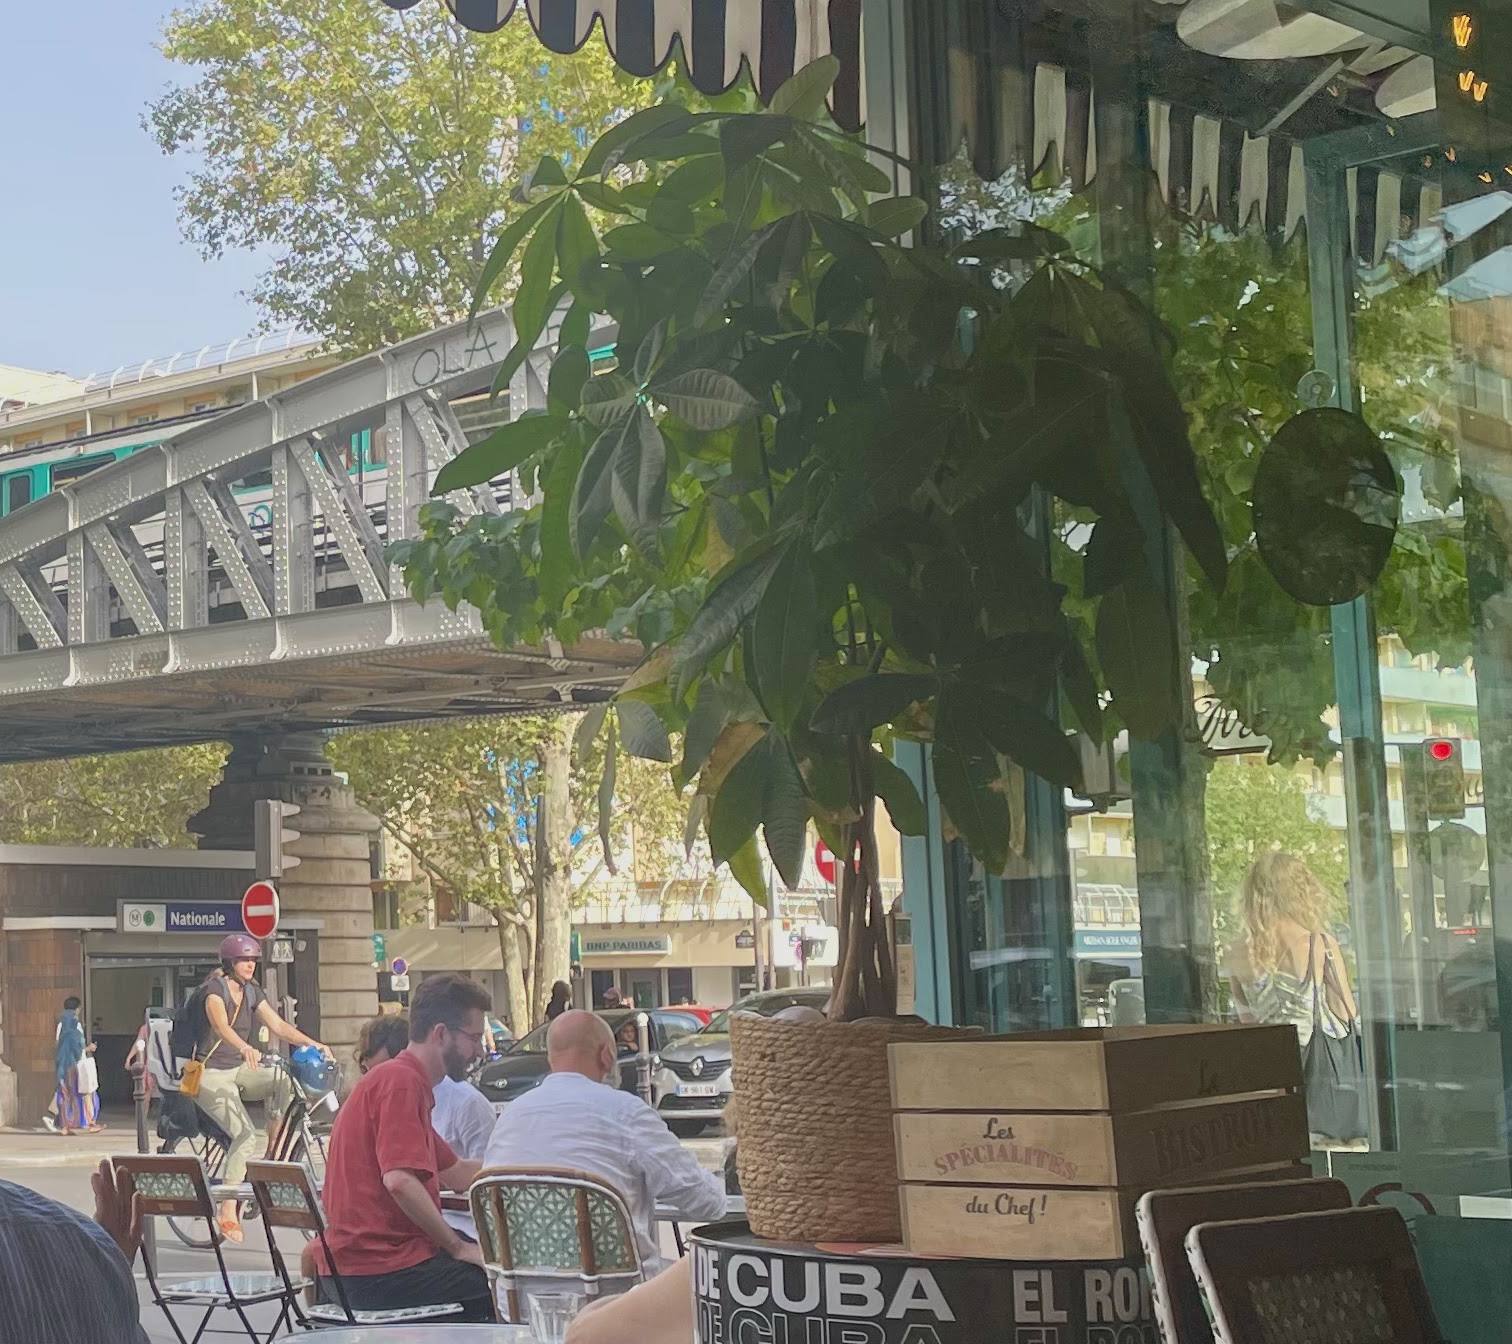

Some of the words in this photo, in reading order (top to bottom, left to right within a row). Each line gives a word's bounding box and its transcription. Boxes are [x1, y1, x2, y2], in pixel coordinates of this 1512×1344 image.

[170, 911, 226, 926] Nationale
[586, 942, 610, 951] BNP
[613, 940, 661, 950] PARIBAS
[982, 1117, 1016, 1140] Les
[934, 1142, 1078, 1181] SPÉCIALITÉS
[966, 1196, 989, 1215] du
[697, 1247, 721, 1299] DE
[727, 1254, 957, 1322] CUBA
[1013, 1269, 1068, 1324] EL
